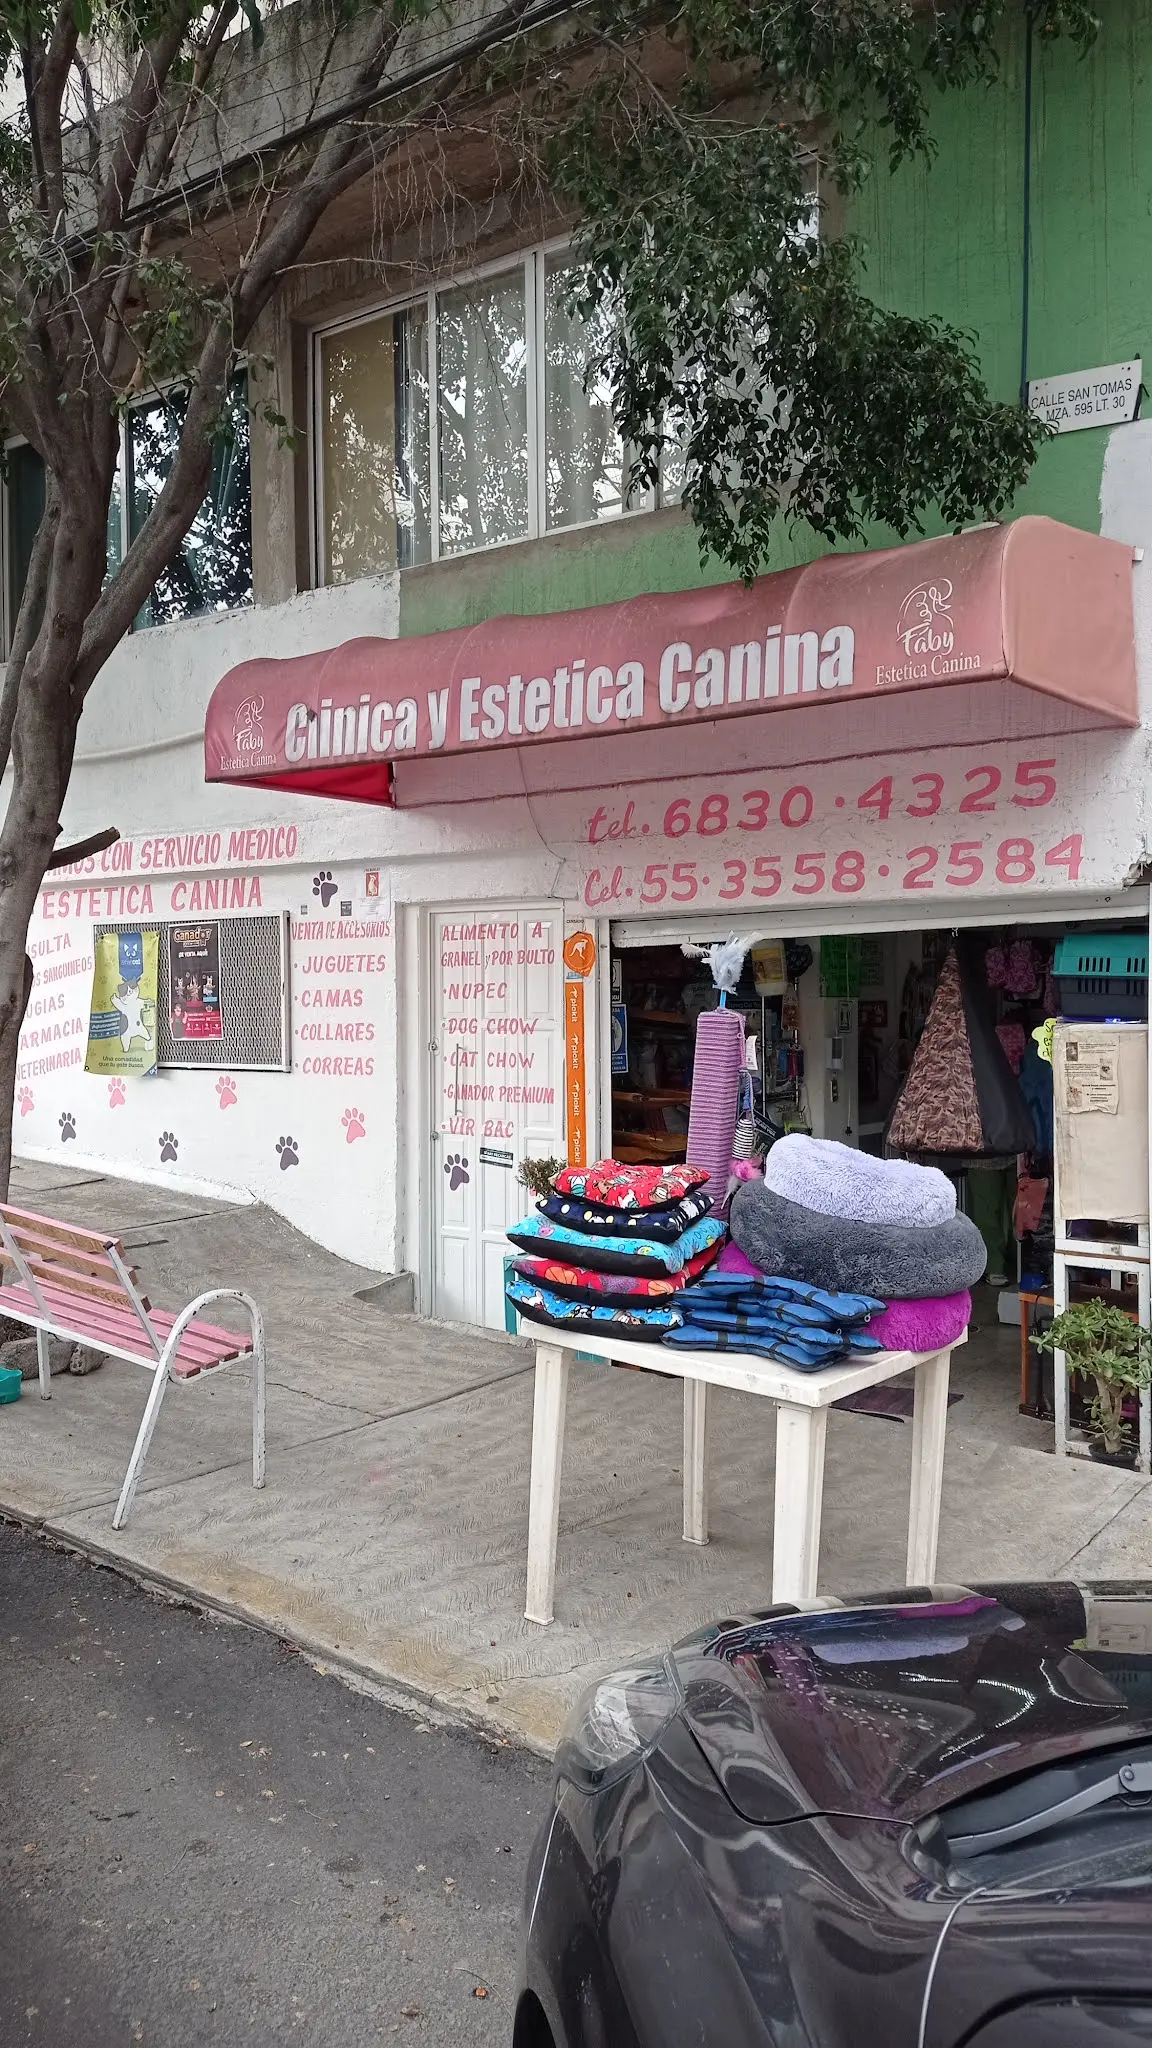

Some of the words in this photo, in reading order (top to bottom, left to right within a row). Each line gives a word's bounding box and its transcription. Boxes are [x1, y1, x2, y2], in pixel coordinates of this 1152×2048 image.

[1031, 391, 1064, 410] CALLE
[1068, 387, 1090, 402] SAN
[1093, 378, 1132, 396] TOMAS
[1046, 406, 1071, 421] MZA.
[1074, 402, 1093, 416] 595
[1096, 398, 1109, 412] LT.
[1112, 396, 1126, 409] 30
[875, 662, 928, 686] Estetica
[932, 652, 981, 676] Canina
[428, 687, 450, 750] y
[459, 658, 645, 741] Estetica
[658, 623, 855, 715] Canina
[220, 756, 250, 771] Estetica
[250, 751, 276, 767] Canina
[587, 801, 650, 844] tel.
[101, 840, 133, 872] CON
[140, 833, 221, 870] SERVICIO
[228, 825, 298, 861] MEDICO
[42, 883, 154, 920] ESTETICA
[170, 876, 262, 912] CANINA
[291, 921, 324, 940] VENTA
[326, 921, 336, 939] DE
[336, 920, 390, 940] ACCESORIOS
[442, 922, 519, 942] ALIMENTO
[532, 921, 542, 938] A
[302, 954, 386, 974] JUGUETES
[441, 950, 481, 968] GRANEL
[491, 950, 514, 966] POR
[517, 949, 555, 965] BULTO
[43, 956, 93, 985] SANGUINEOS
[300, 988, 364, 1008] CAMAS
[448, 982, 507, 1000] NUPEC
[300, 1022, 375, 1042] COLLARES
[448, 1018, 478, 1034] DOG
[486, 1018, 539, 1035] CHOW
[302, 1056, 375, 1076] CORREAS
[450, 1051, 478, 1068] CAT
[487, 1052, 535, 1068] CHOW
[447, 1084, 495, 1102] GANADOR
[499, 1086, 554, 1104] PREMIUM
[449, 1117, 475, 1136] VIR
[484, 1120, 514, 1138] BAC
